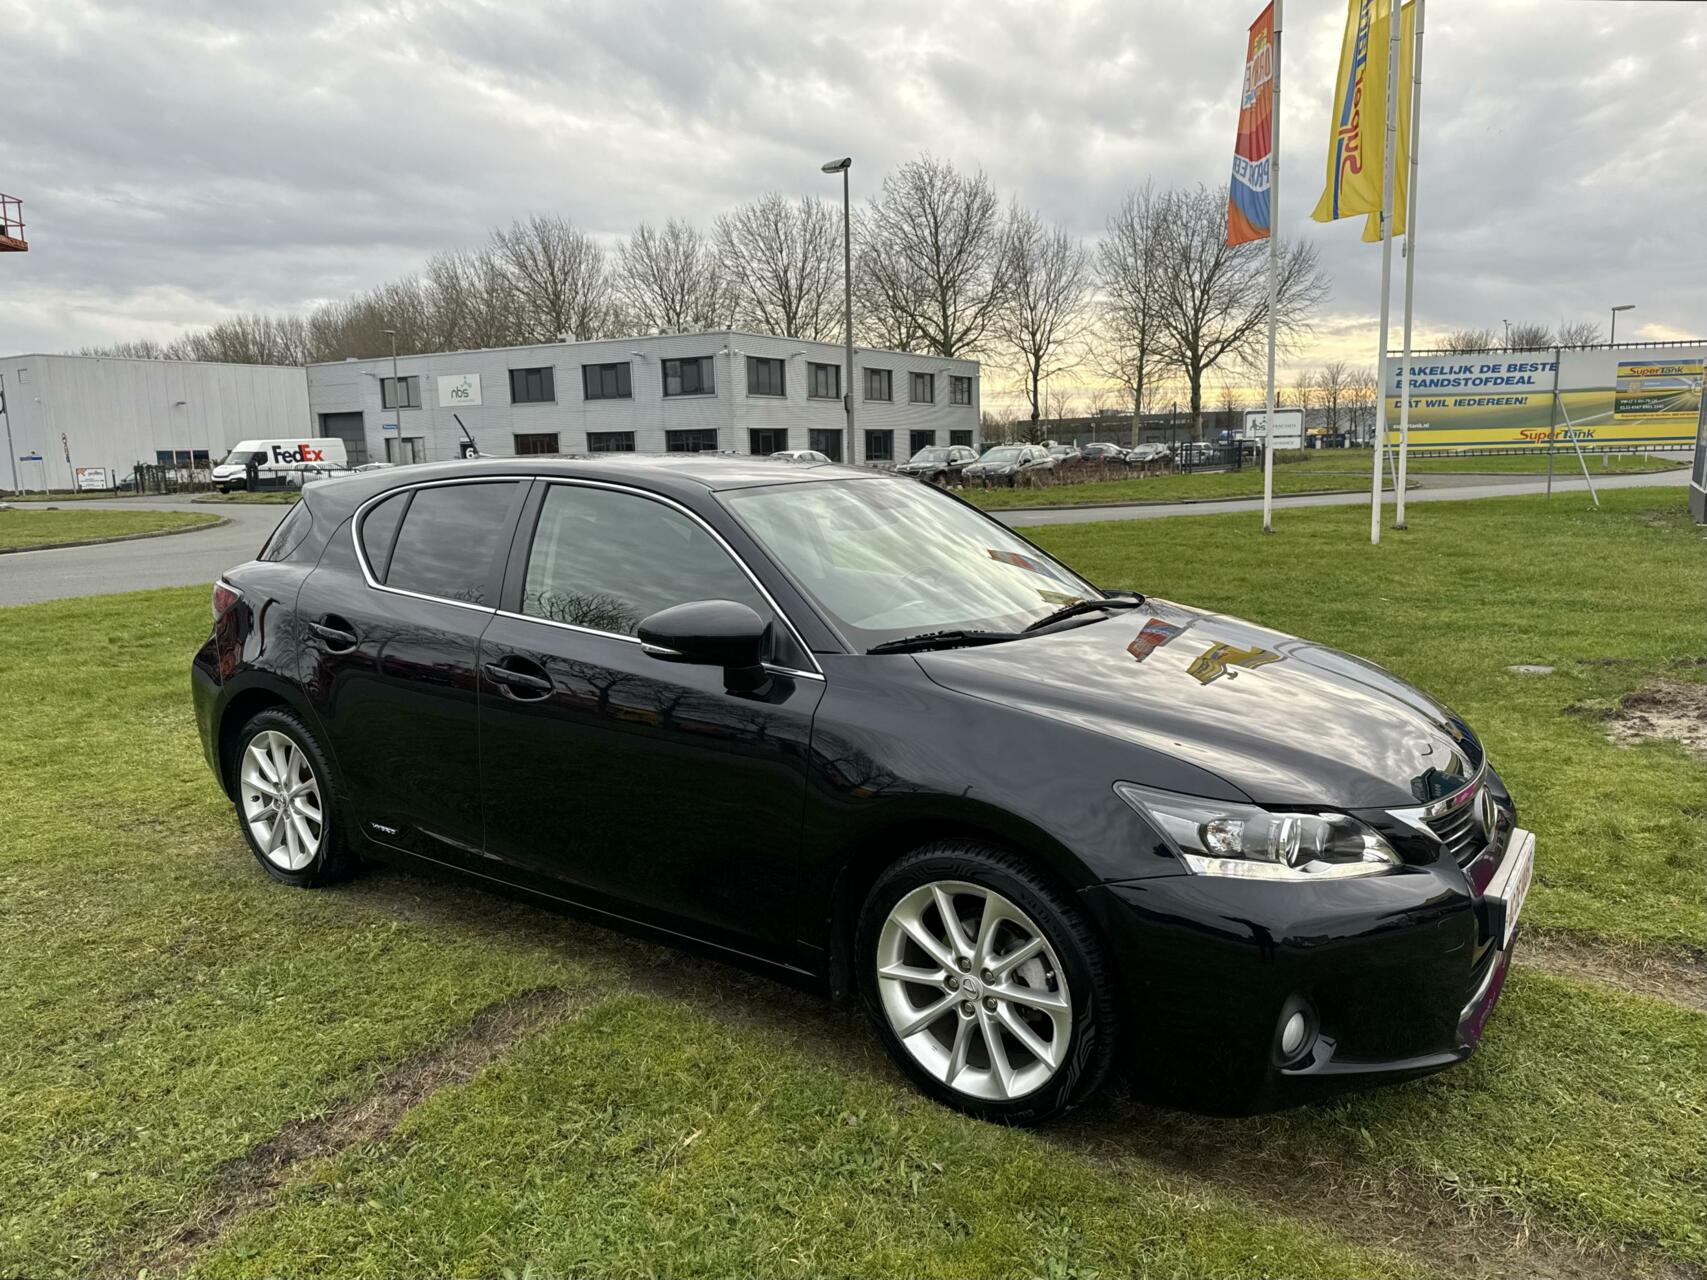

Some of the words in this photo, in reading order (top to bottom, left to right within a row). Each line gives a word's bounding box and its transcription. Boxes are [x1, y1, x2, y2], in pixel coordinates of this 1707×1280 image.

[1479, 364, 1502, 374] DE
[1506, 362, 1559, 373] BESTE
[1629, 366, 1685, 377] SuperTank
[451, 386, 470, 399] nbs
[1425, 399, 1449, 408] WIL
[1453, 397, 1528, 407] IEDEREEN!
[272, 444, 324, 464] FedEx
[465, 447, 475, 459] 6
